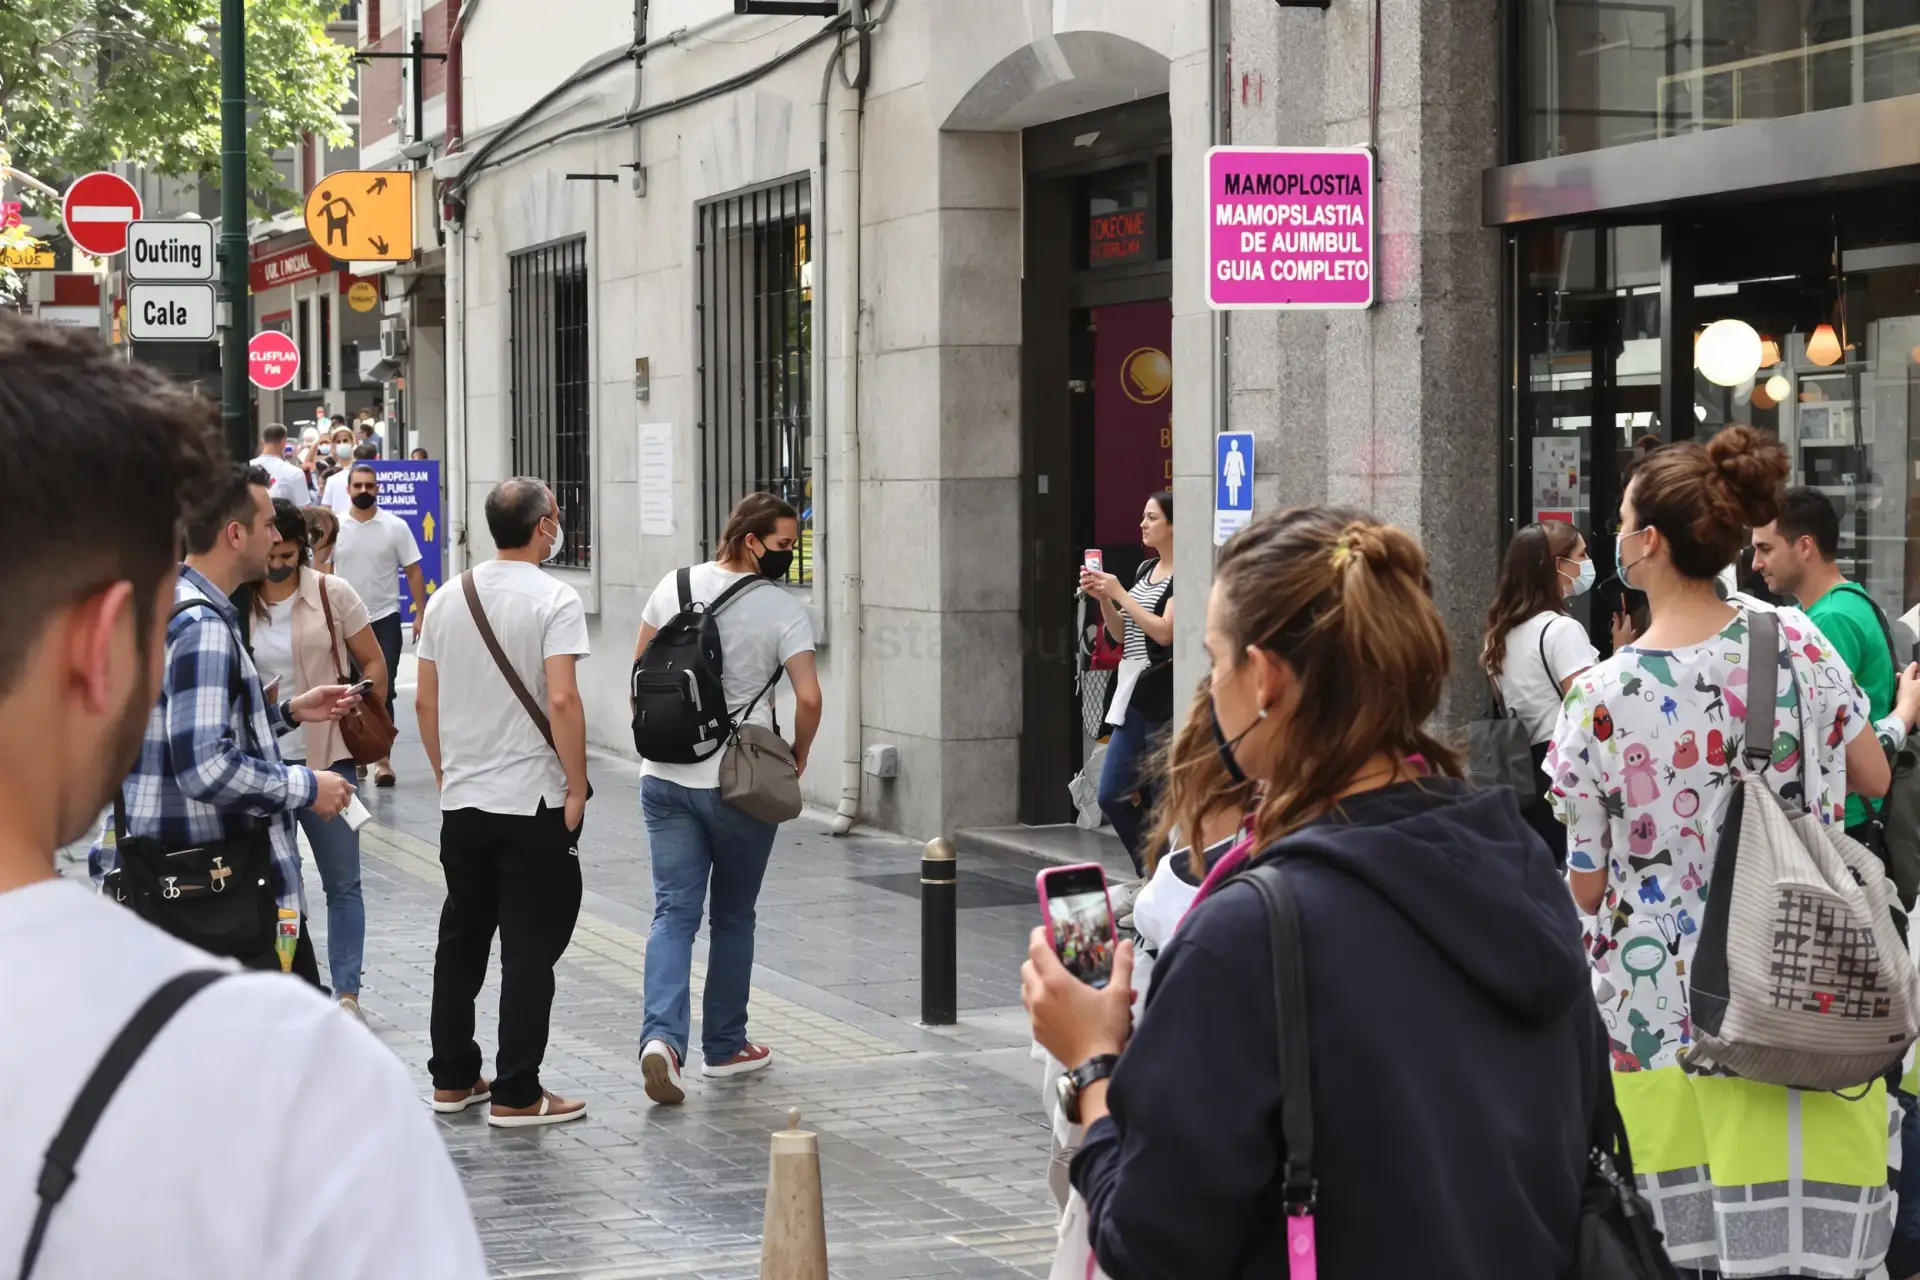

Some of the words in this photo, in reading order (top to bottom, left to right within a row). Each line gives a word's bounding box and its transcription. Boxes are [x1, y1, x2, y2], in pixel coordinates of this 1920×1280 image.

[1224, 174, 1363, 195] MAMOPLOSTIA
[1216, 204, 1365, 226] MAMOPSLASTIA
[135, 237, 202, 268] Outiing
[1240, 232, 1267, 253] DE
[1216, 260, 1266, 281] GUIA
[1270, 260, 1369, 281] COMPLETO
[143, 300, 187, 326] Cala
